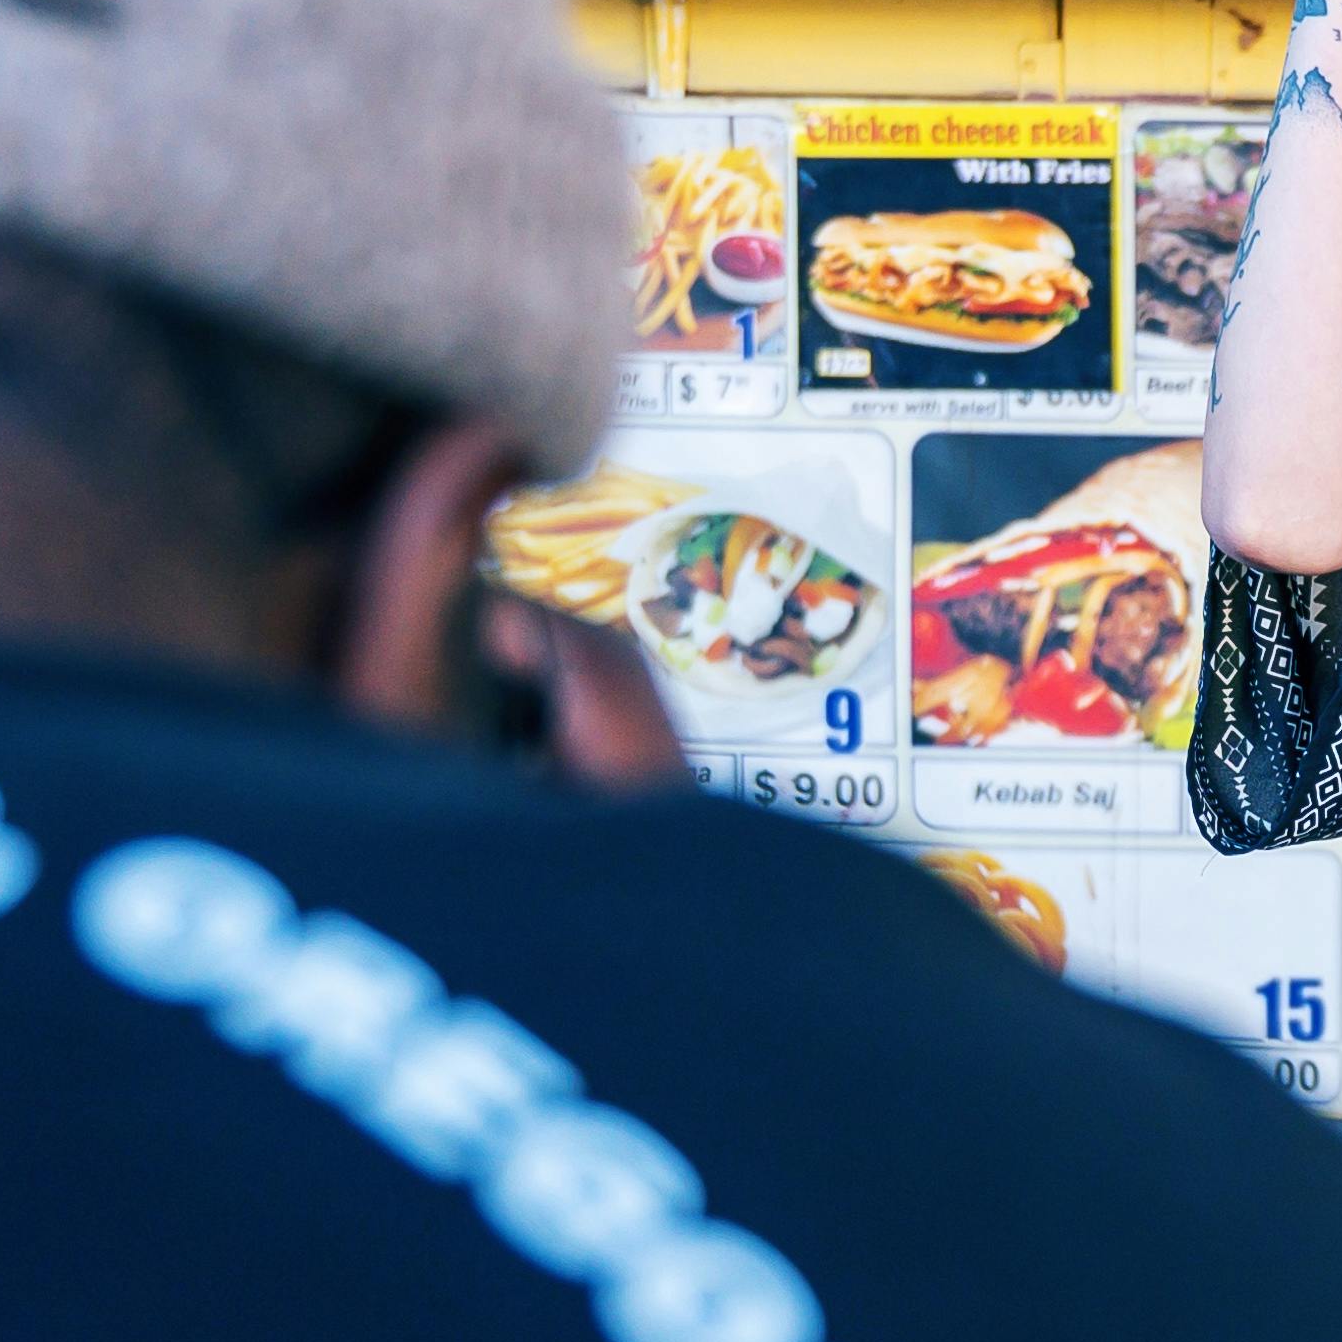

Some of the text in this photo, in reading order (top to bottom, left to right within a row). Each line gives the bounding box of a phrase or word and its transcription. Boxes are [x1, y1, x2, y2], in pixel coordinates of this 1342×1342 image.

[806, 114, 1107, 147] Chicken cheese steak
[954, 158, 1112, 184] With Fries
[734, 311, 755, 360] 1
[823, 687, 863, 754] 9
[754, 768, 777, 809] $
[792, 772, 885, 808] 9.00
[973, 781, 1117, 810] Kebab Saj
[1255, 976, 1326, 1043] 15
